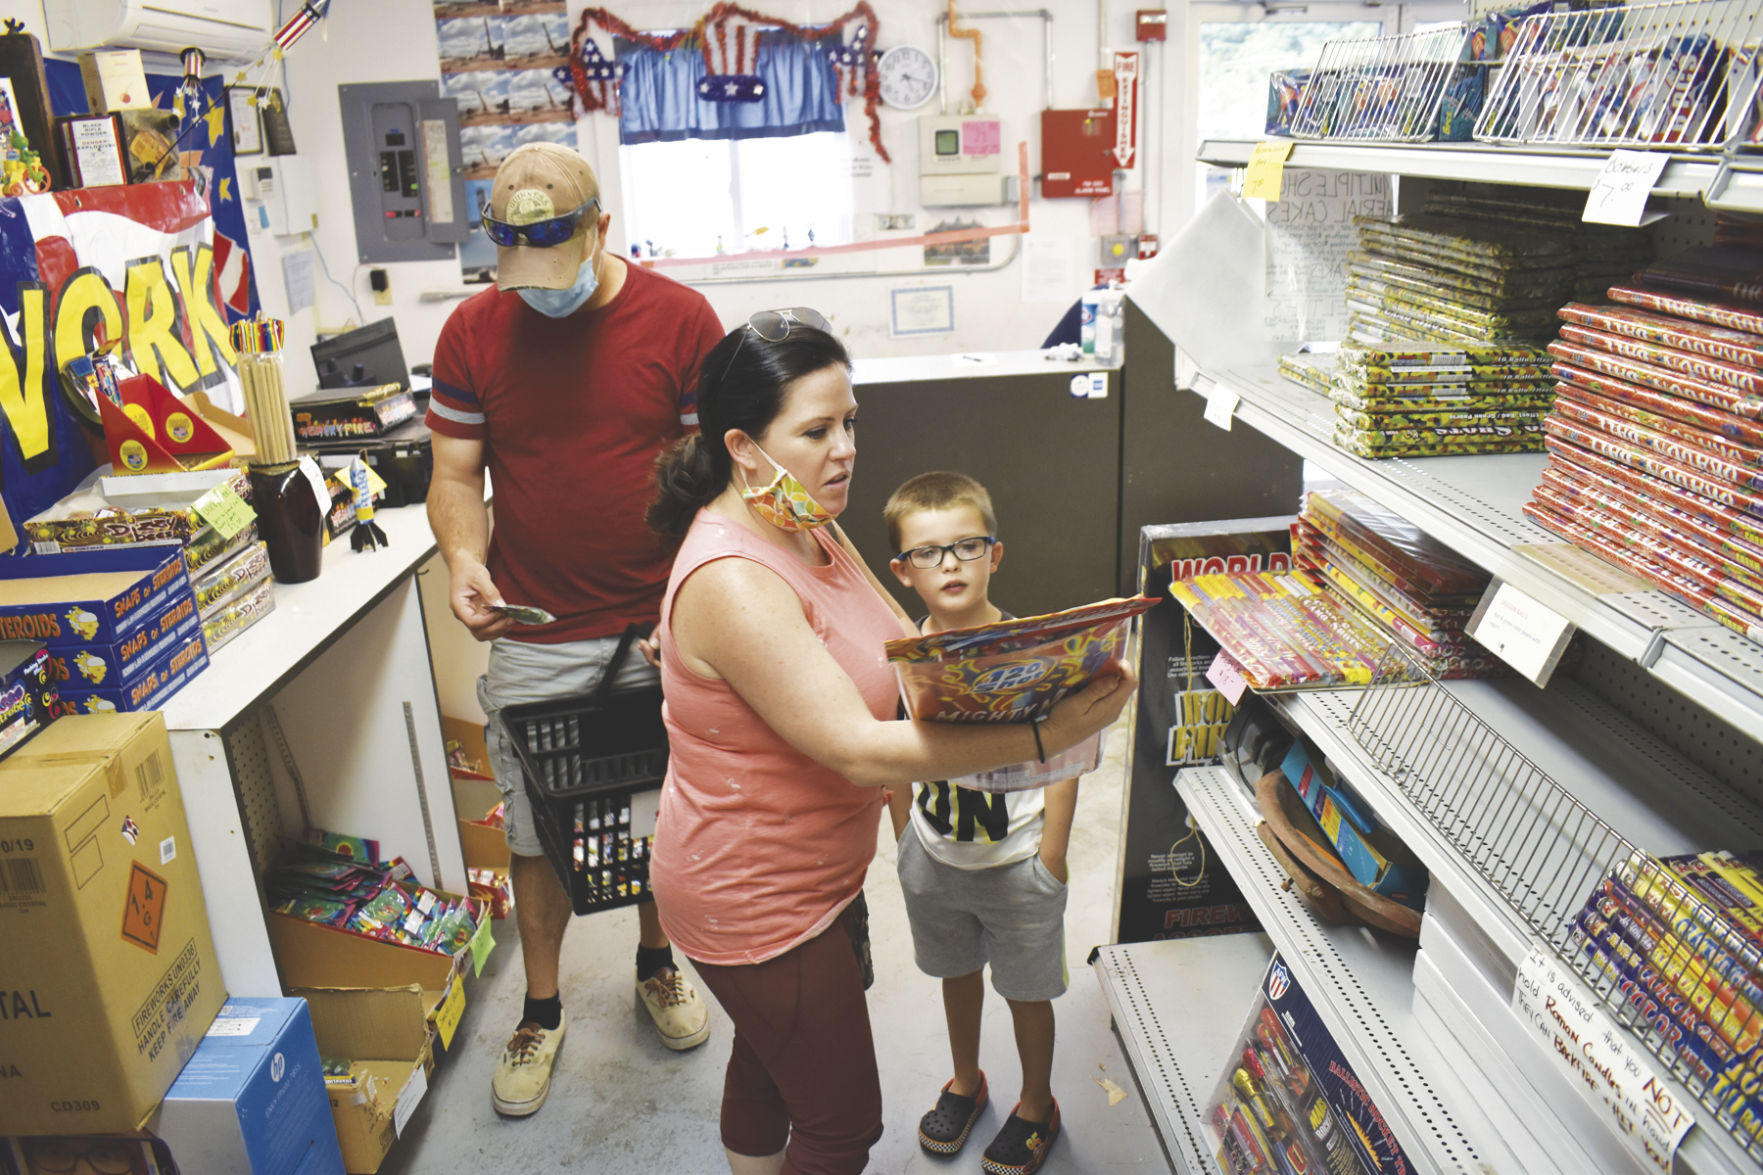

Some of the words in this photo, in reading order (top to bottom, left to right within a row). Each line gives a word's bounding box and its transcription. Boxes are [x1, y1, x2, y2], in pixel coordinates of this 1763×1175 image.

[936, 702, 1038, 721] MIGHTY
[135, 973, 174, 1032] FIREWORKS
[137, 1009, 166, 1056] HANDLE
[166, 958, 200, 1014] CAREFULLY
[148, 1030, 167, 1064] KEEP
[167, 1009, 184, 1036] FIRE
[183, 980, 200, 1013] AWAY
[1518, 967, 1541, 999] hold
[1529, 949, 1545, 968] It
[1547, 970, 1556, 984] is
[1556, 982, 1595, 1024] advised
[1601, 1030, 1623, 1056] that
[1624, 1055, 1642, 1079] you
[1642, 1076, 1690, 1129] NOT
[1327, 1058, 1371, 1106] BALLISTIC
[1368, 1102, 1401, 1156] ROCKET
